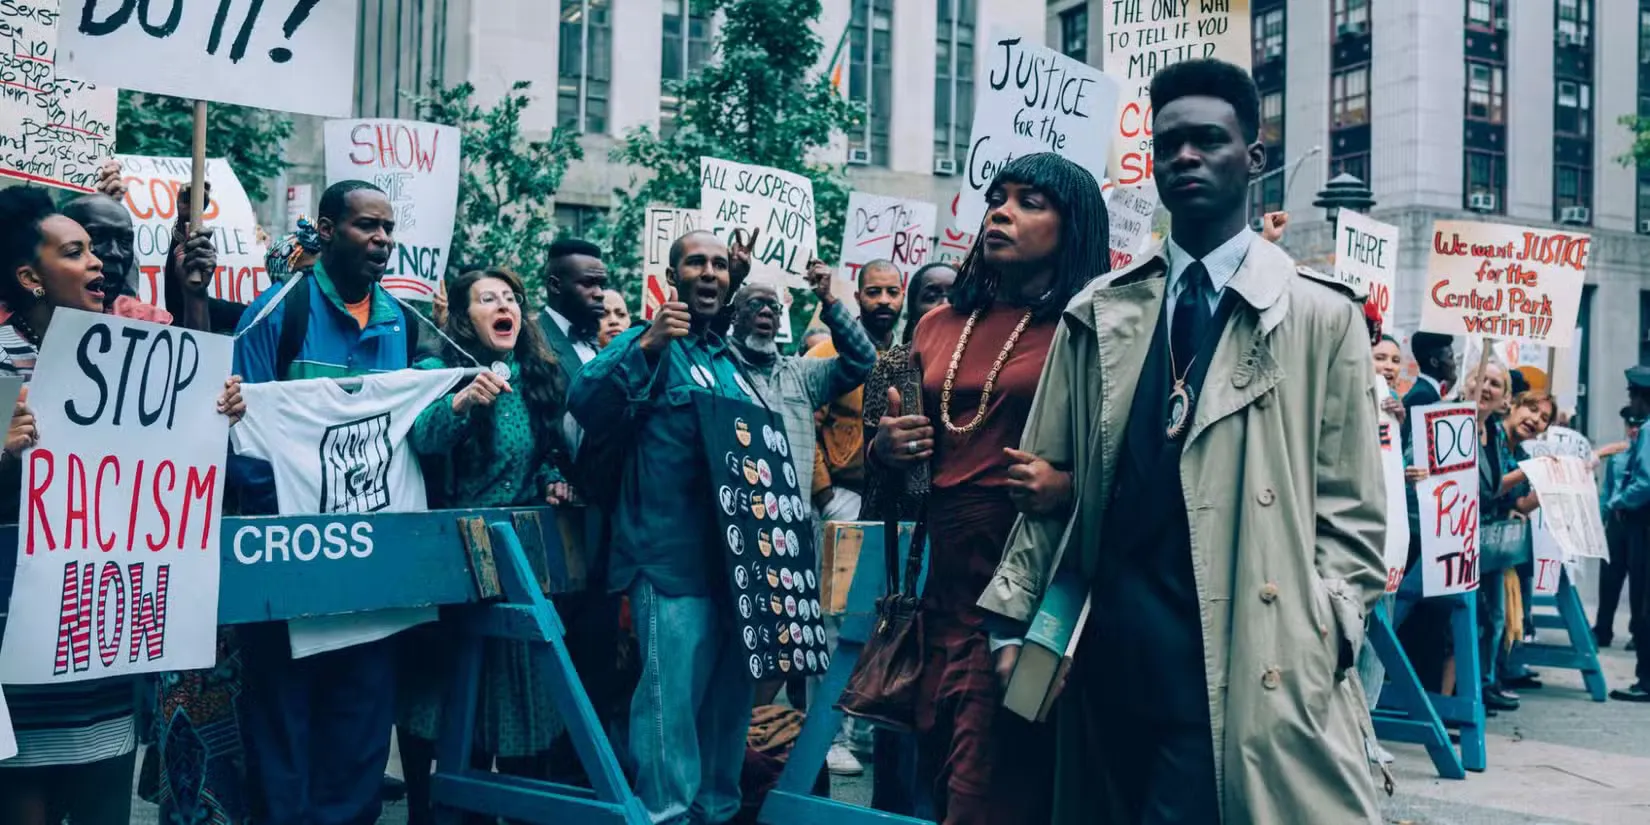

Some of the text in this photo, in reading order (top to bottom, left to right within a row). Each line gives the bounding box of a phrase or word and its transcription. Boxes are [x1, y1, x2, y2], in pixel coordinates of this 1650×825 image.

[1107, 16, 1229, 54] TO TELL IF YOU
[1112, 0, 1145, 26] THE
[1150, 0, 1190, 22] ONLY
[989, 37, 1098, 118] JUSTICE
[34, 139, 98, 165] Justice
[349, 123, 440, 174] SHOW
[1040, 116, 1066, 153] the
[700, 163, 812, 222] ALL SUSPECTS
[715, 198, 812, 243] ARE NOT
[1344, 225, 1389, 270] THERE
[1434, 230, 1592, 272] We want JUSTICE
[1474, 259, 1538, 288] for the
[1431, 278, 1553, 318] Central Park
[64, 322, 200, 431] STOP
[1434, 417, 1475, 466] DO
[25, 448, 218, 556] RACISM
[232, 521, 374, 565] CROSS
[53, 560, 170, 677] NOW
